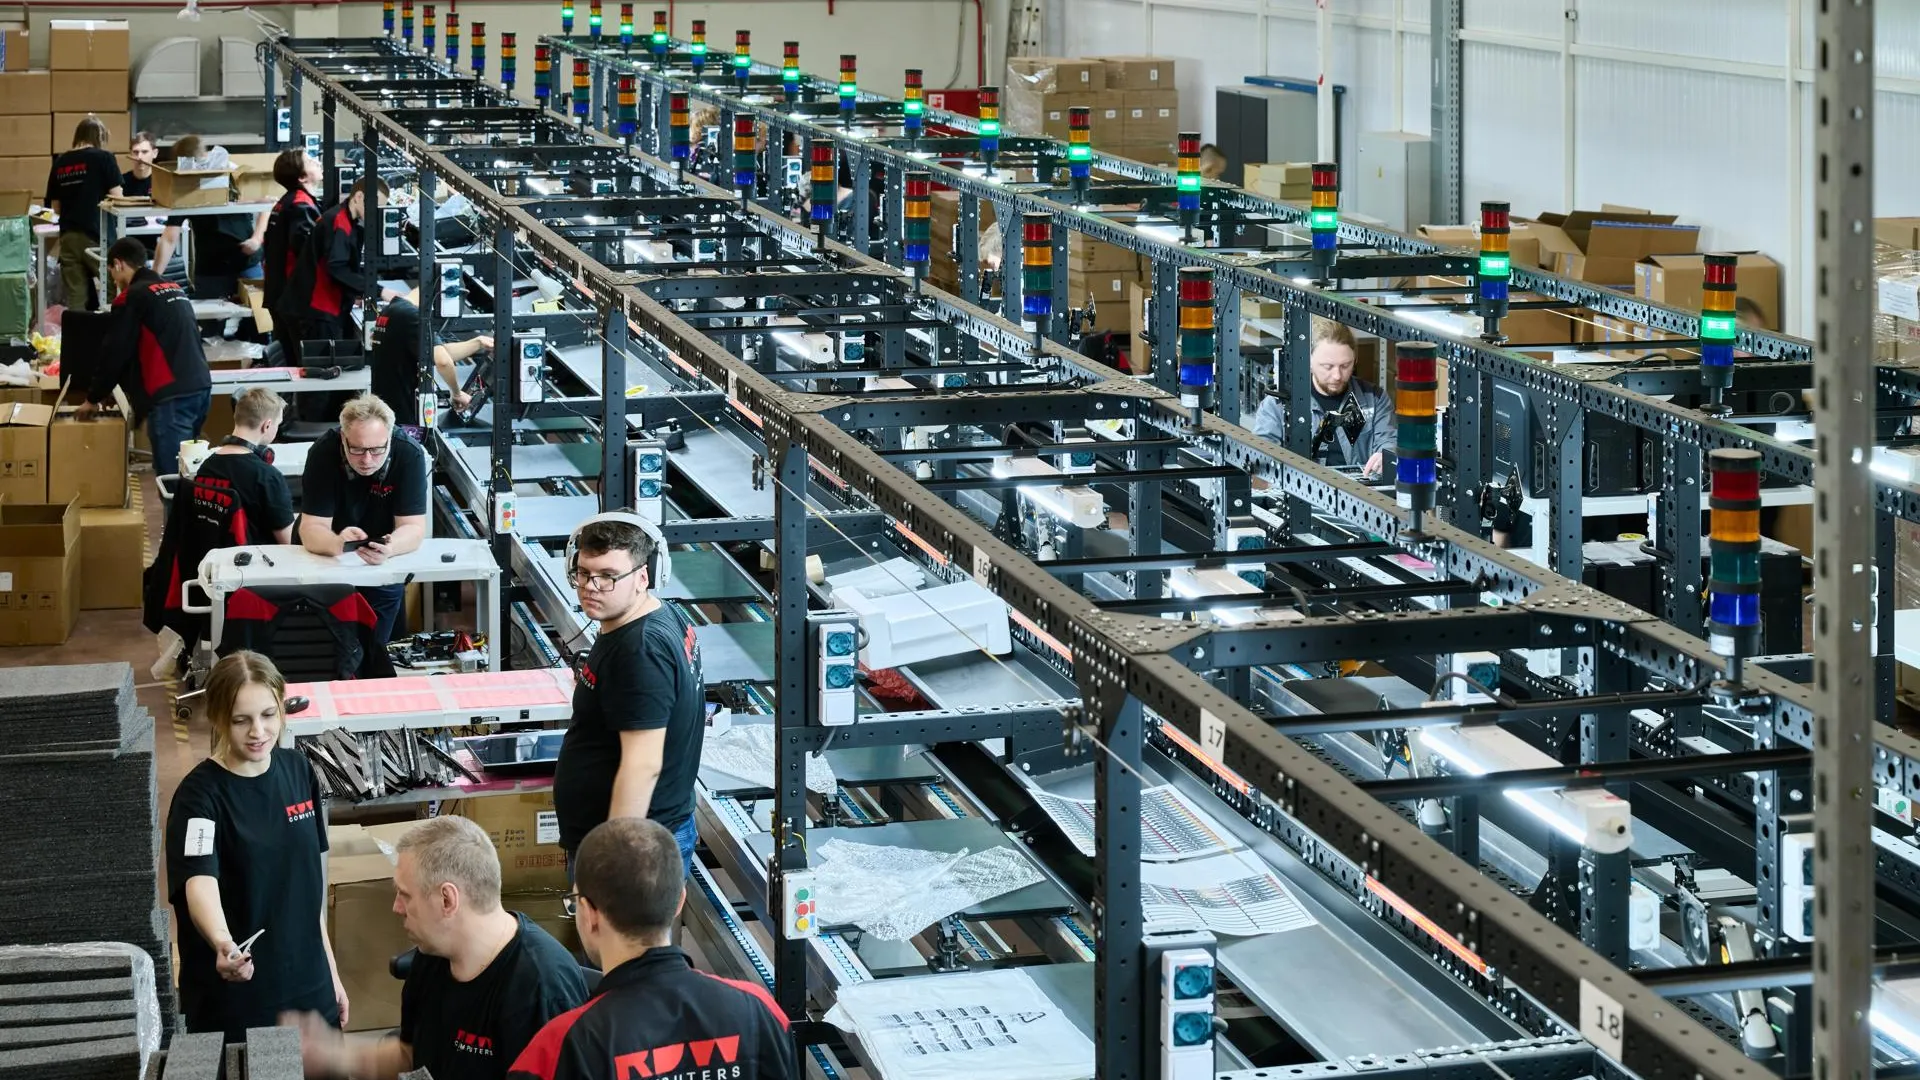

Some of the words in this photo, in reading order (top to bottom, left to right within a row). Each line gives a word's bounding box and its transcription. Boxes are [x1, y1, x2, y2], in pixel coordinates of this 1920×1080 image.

[978, 558, 988, 578] 16
[1208, 725, 1223, 748] 17
[1596, 1006, 1620, 1040] 18
